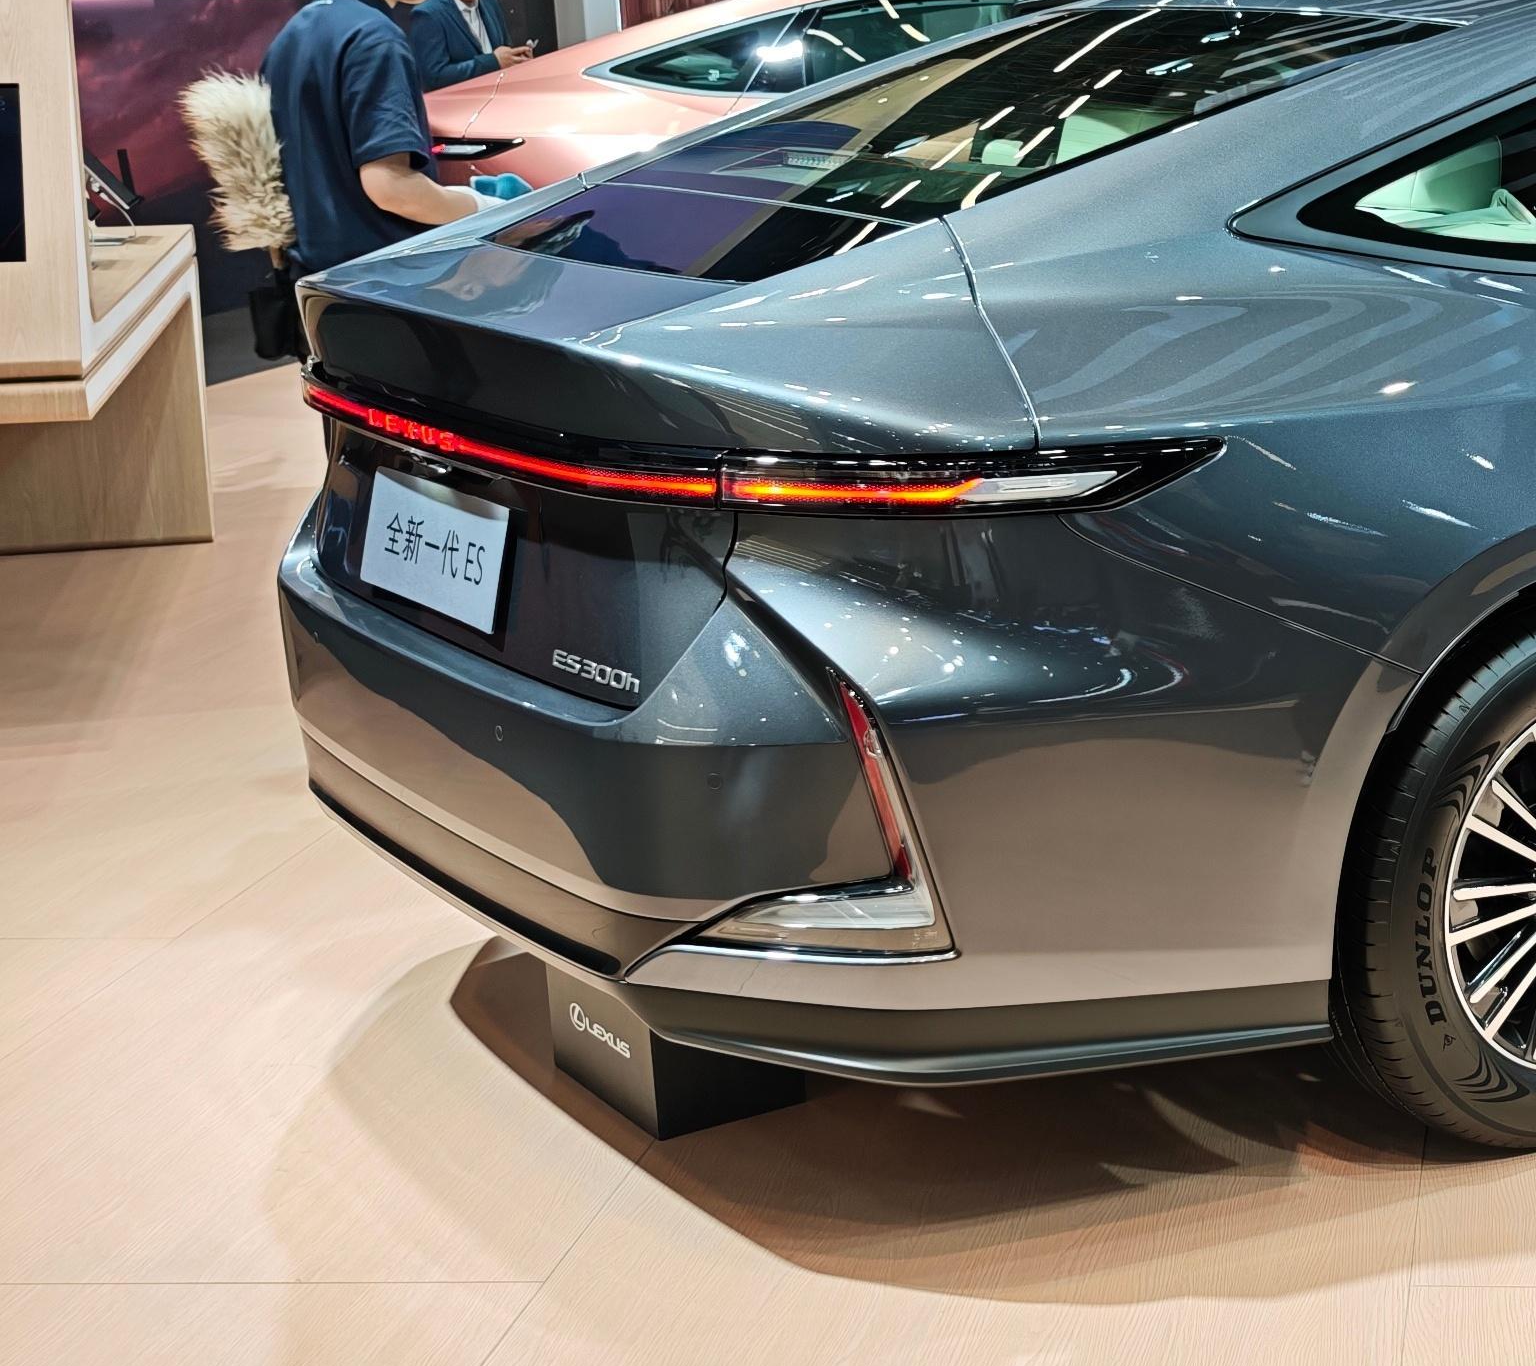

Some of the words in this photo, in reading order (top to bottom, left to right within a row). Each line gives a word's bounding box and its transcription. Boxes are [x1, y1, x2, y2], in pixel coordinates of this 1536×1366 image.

[368, 408, 455, 452] LEXUS
[384, 512, 460, 579] 全新一代
[463, 541, 486, 586] ES
[1415, 847, 1447, 1026] DUNLOP
[585, 1016, 631, 1059] LEXUS
